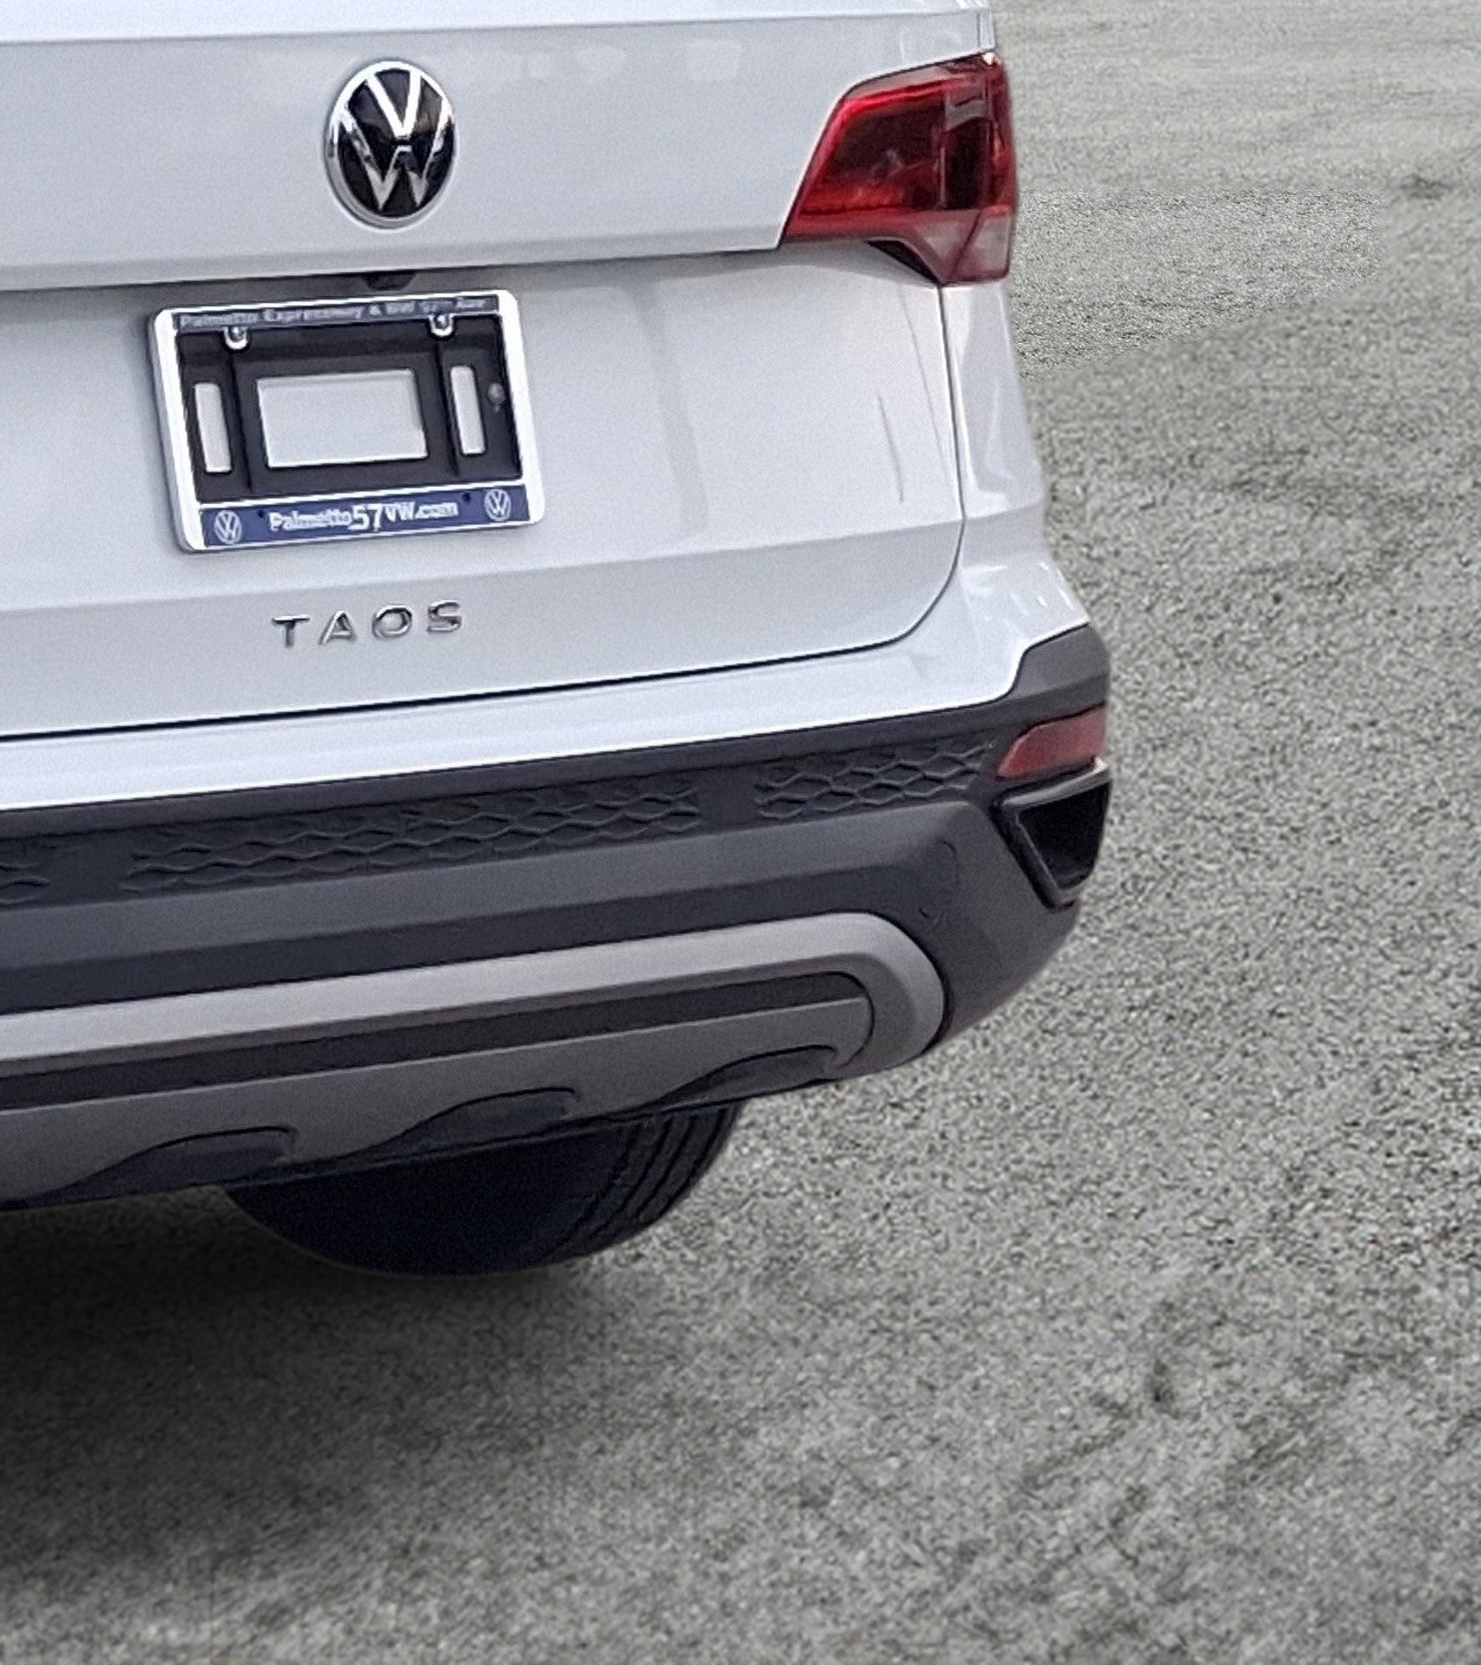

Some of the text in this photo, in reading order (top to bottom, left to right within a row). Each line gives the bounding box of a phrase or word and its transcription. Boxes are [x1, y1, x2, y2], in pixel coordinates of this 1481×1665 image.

[330, 64, 454, 215] VW
[269, 501, 459, 533] Palmetto57VW.com
[272, 599, 463, 648] TAOS
